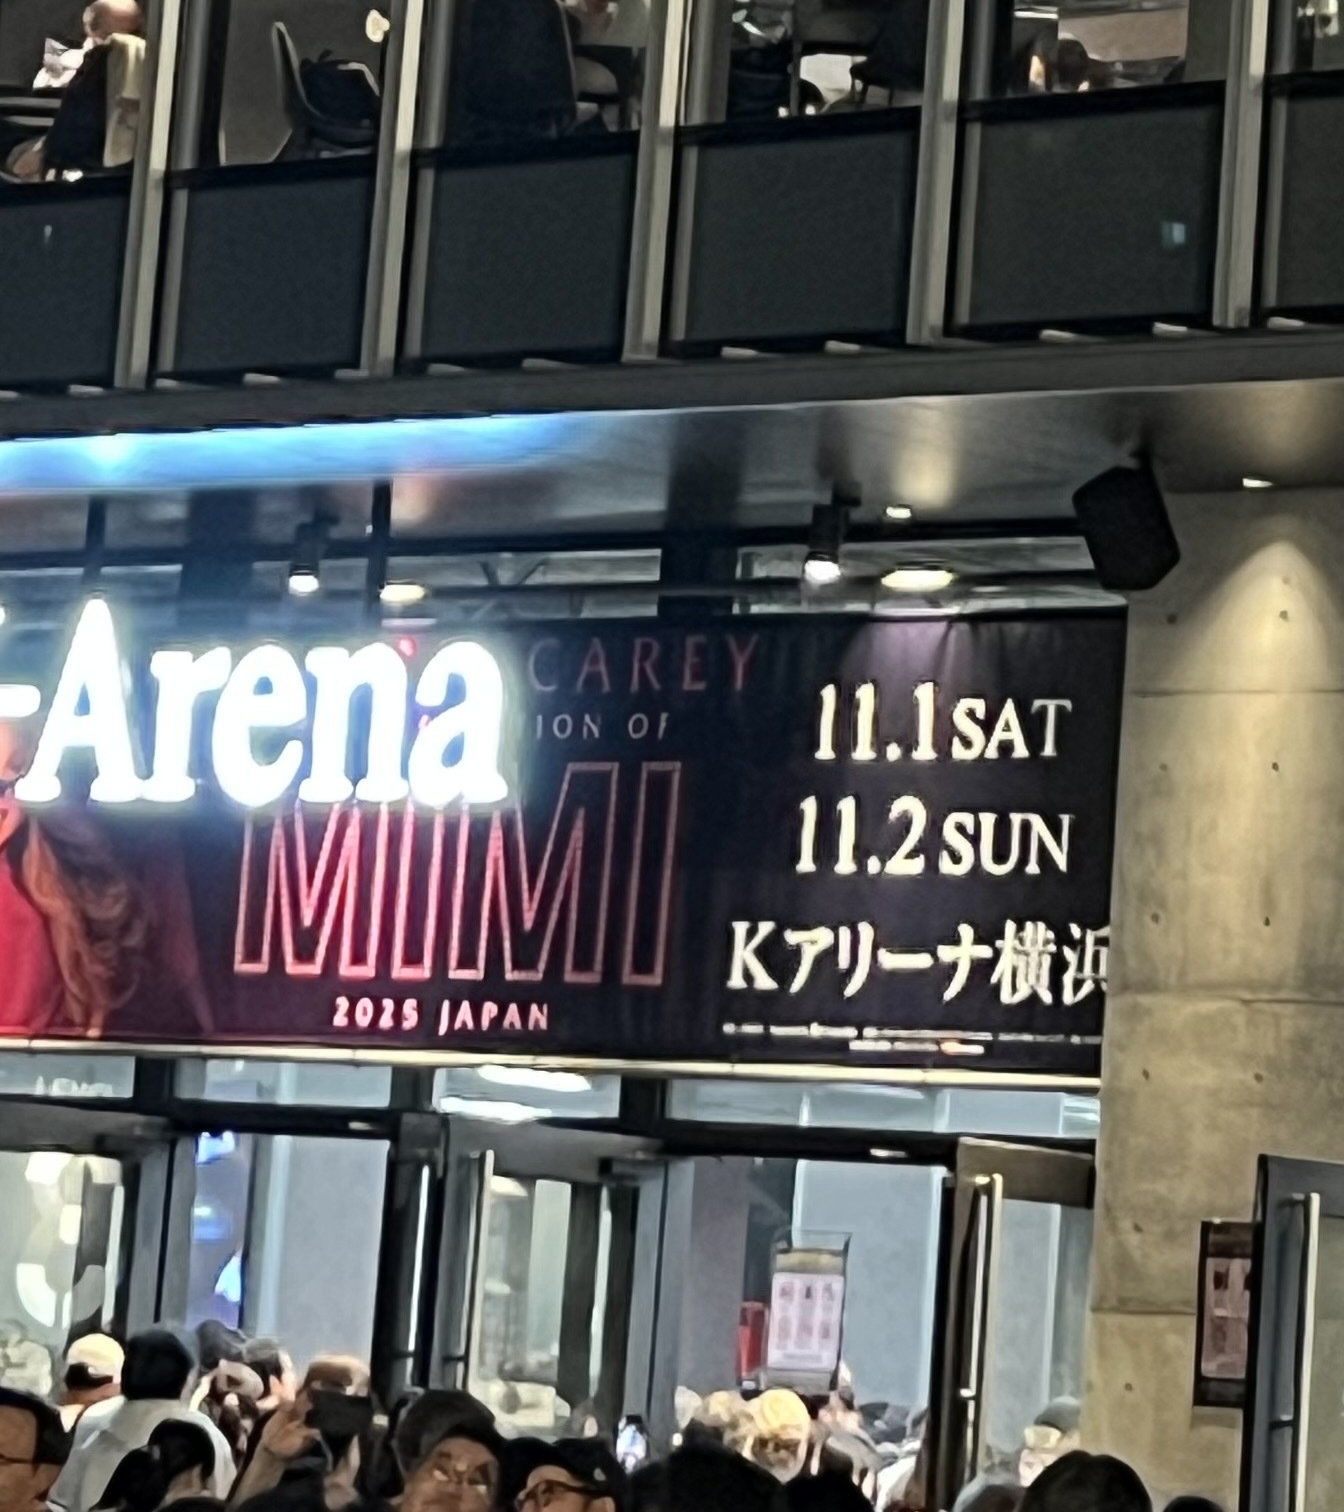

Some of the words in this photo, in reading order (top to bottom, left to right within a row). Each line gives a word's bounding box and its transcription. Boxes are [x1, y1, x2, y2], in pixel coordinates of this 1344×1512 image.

[527, 636, 759, 693] CAREY
[332, 995, 419, 1032] 2025
[437, 998, 549, 1037] JAPAN
